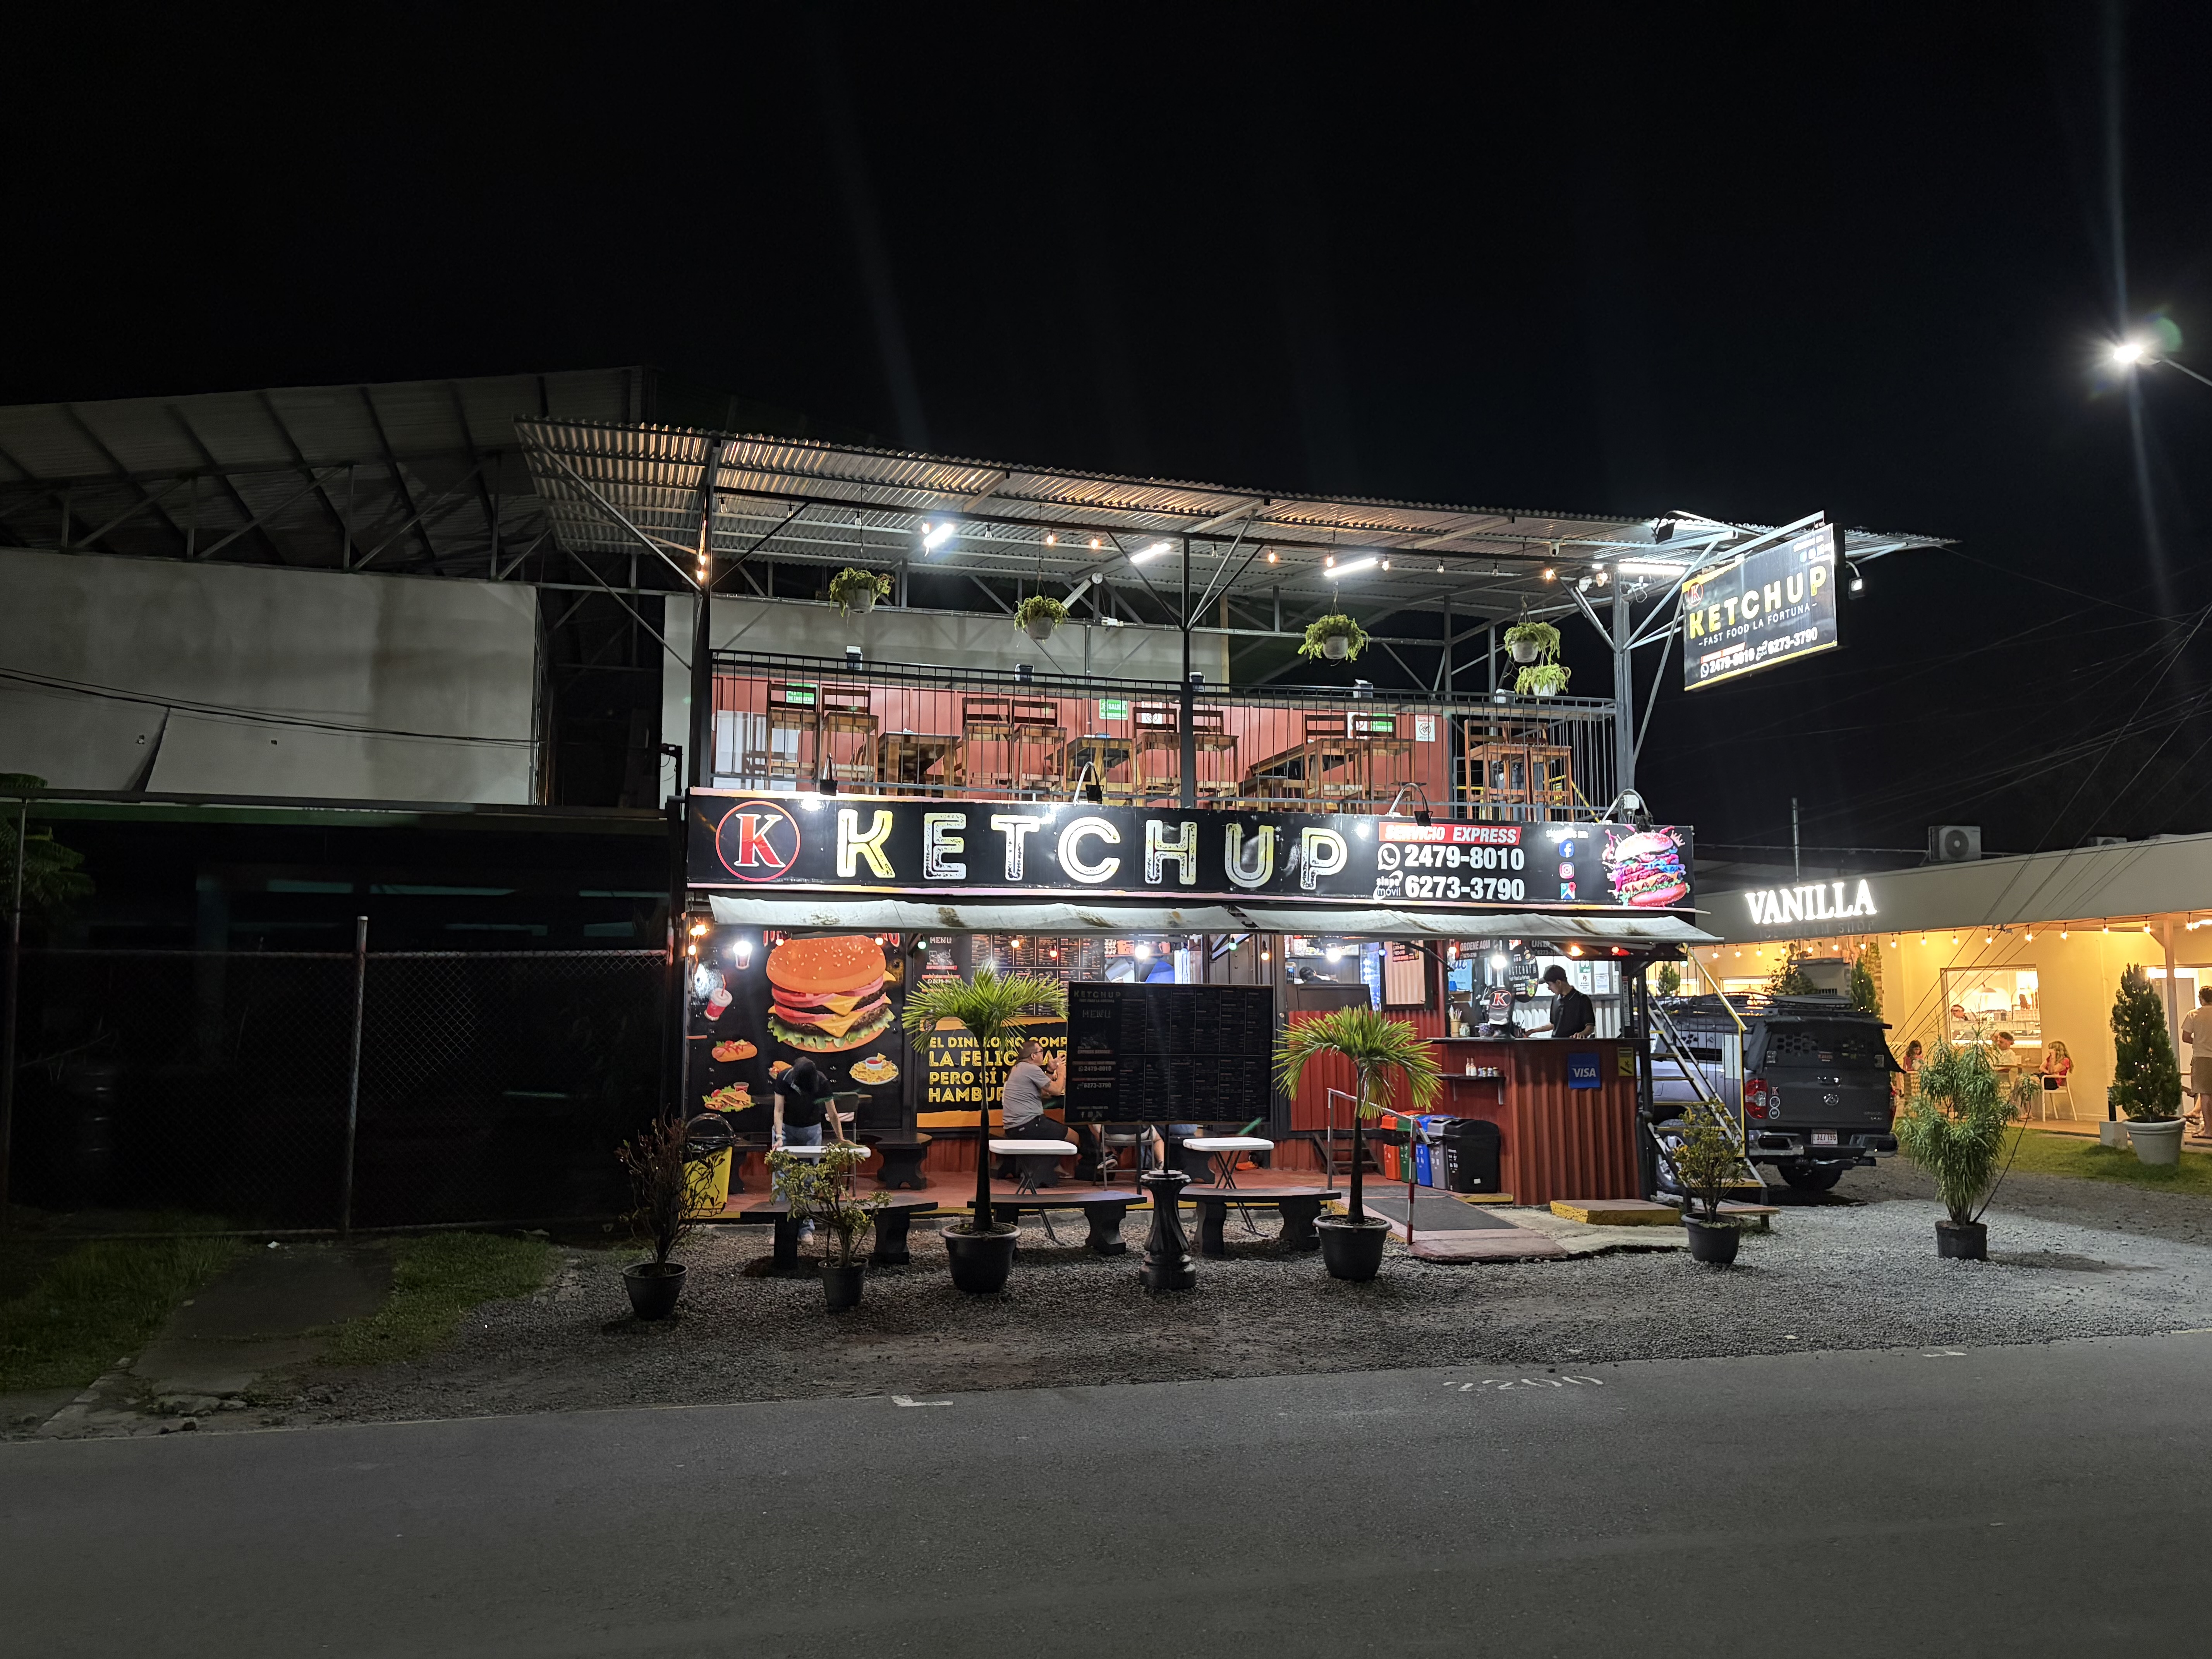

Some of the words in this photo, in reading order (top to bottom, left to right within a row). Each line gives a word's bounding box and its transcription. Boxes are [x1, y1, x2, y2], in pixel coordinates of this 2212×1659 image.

[1690, 565, 1826, 639] KETCHUP
[1691, 584, 1701, 604] K
[1726, 623, 1749, 639] FOOD
[1753, 618, 1764, 630] LA
[734, 814, 786, 868] K
[1384, 824, 1446, 841] SERVICIO
[1453, 826, 1516, 844] EXPRESS
[836, 808, 1348, 890] KETCHUP
[1405, 844, 1525, 871] 2479-8010
[1377, 886, 1401, 896] móvil
[1405, 875, 1525, 901] 6273-3790
[1745, 879, 1877, 924] VANILLA
[1759, 928, 1778, 939] ICE
[1786, 923, 1829, 937] CREAM
[1839, 921, 1874, 933] SHOP
[1074, 990, 1121, 998] KETCHUP
[1492, 993, 1508, 1006] K
[1082, 1009, 1111, 1018] MENU
[929, 1037, 944, 1048] EL
[929, 1051, 954, 1066] LA
[929, 1072, 974, 1085] PERO
[1571, 1068, 1596, 1078] VISA
